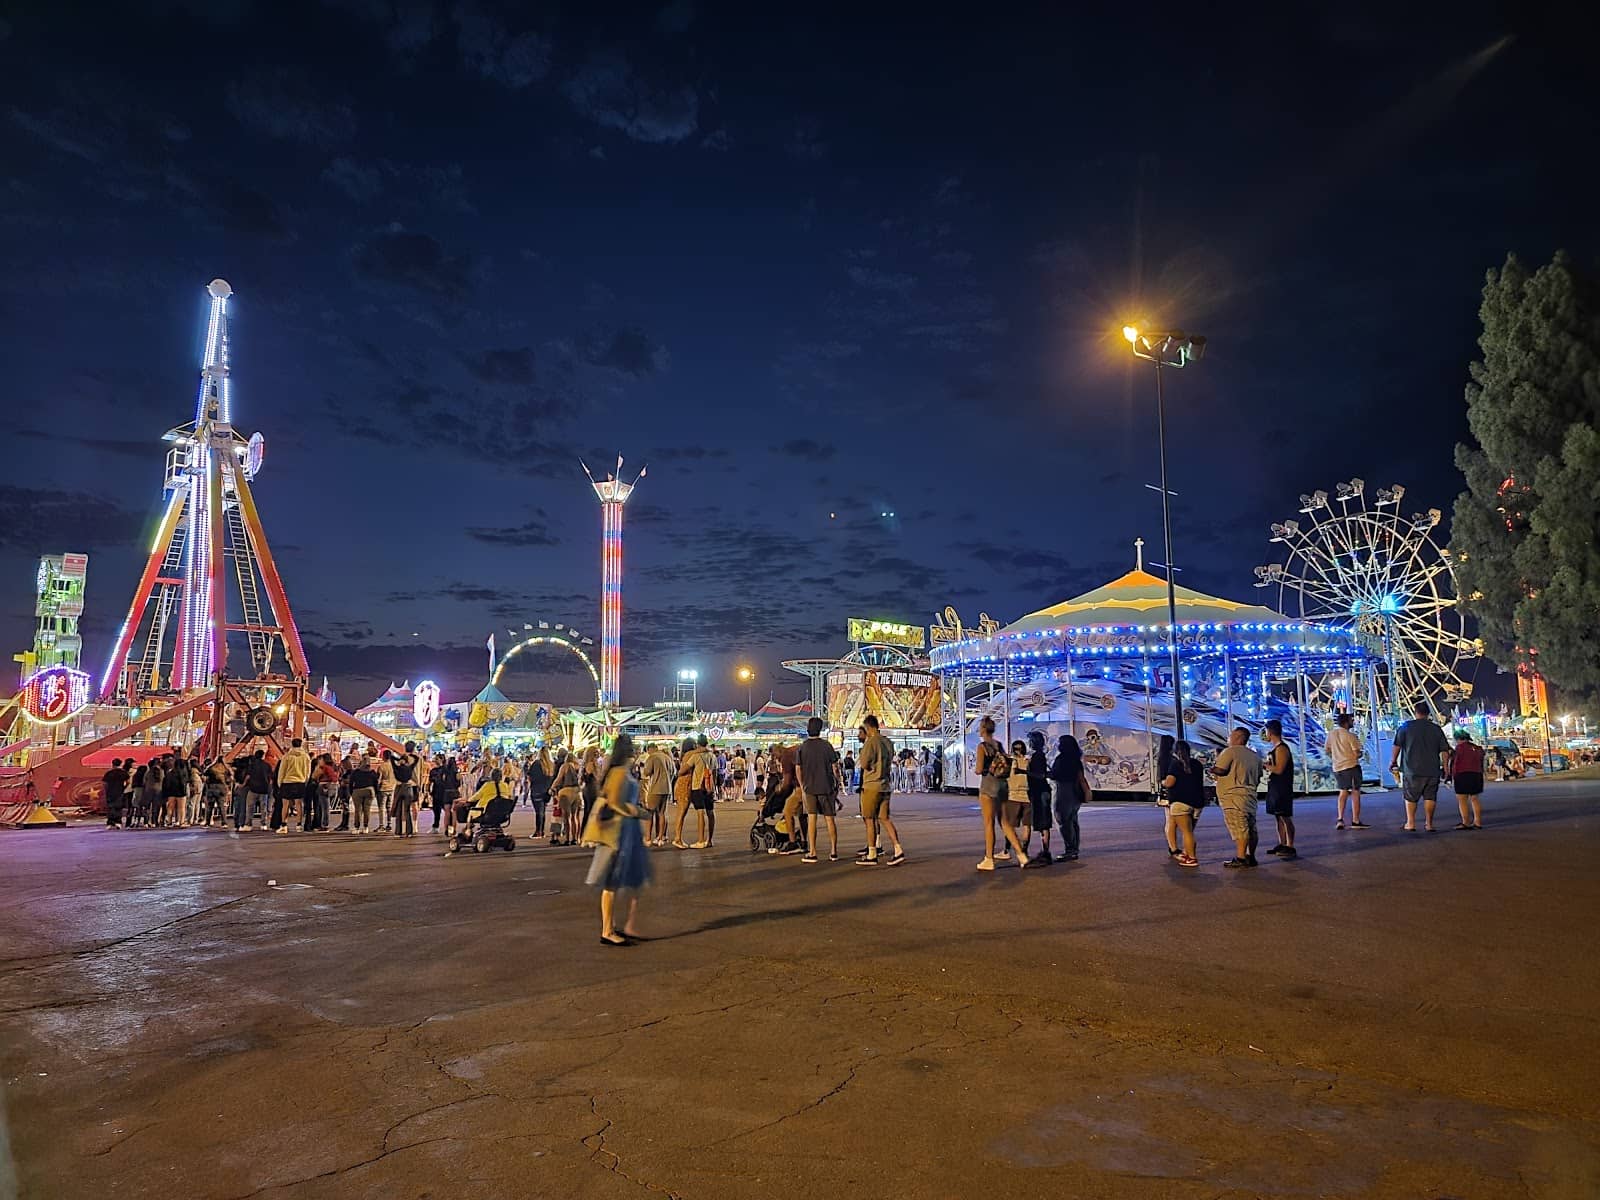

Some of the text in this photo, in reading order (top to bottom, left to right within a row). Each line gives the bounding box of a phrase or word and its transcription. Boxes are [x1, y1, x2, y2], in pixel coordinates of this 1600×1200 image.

[870, 621, 907, 636] POLE
[876, 671, 932, 688] THE DOG HOUSE
